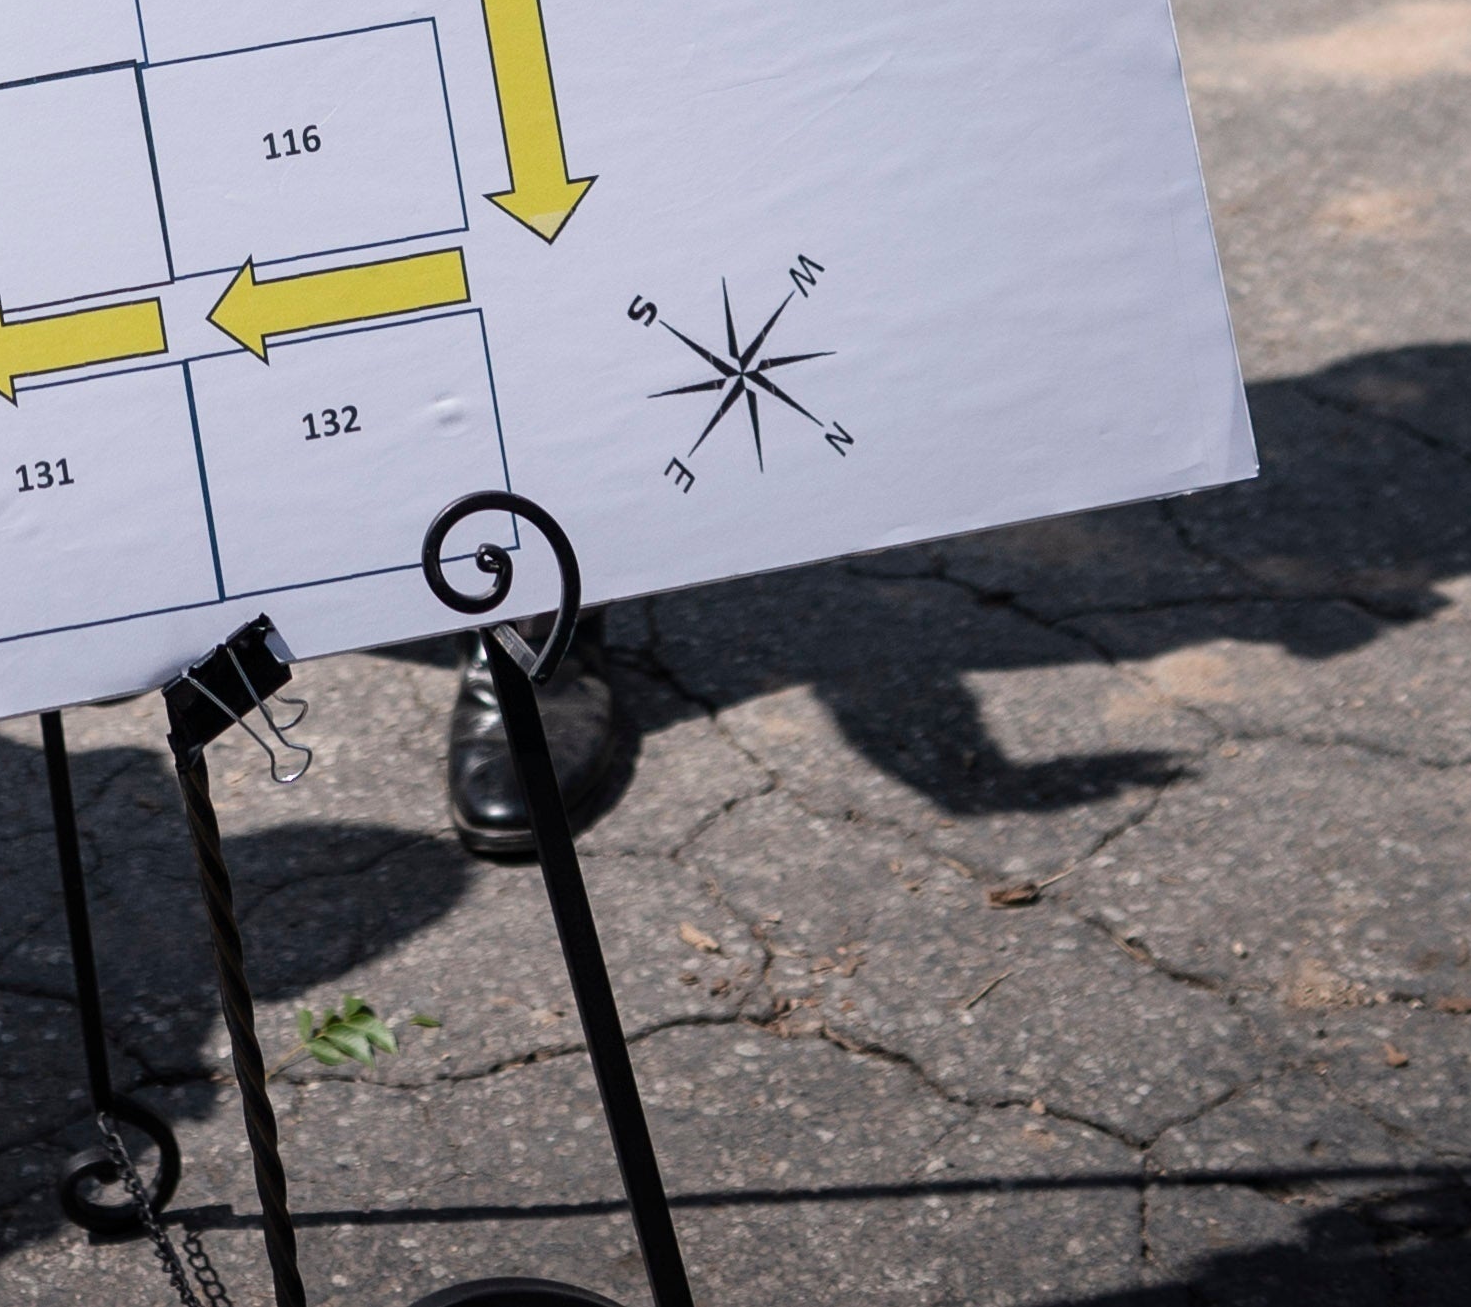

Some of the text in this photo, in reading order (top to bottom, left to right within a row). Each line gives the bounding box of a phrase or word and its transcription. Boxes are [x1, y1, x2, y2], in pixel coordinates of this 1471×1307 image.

[264, 125, 320, 159] 116
[790, 255, 824, 297] W
[628, 295, 657, 326] S
[303, 406, 361, 440] 132
[825, 422, 853, 456] N
[16, 459, 74, 492] 131
[665, 458, 695, 493] E
